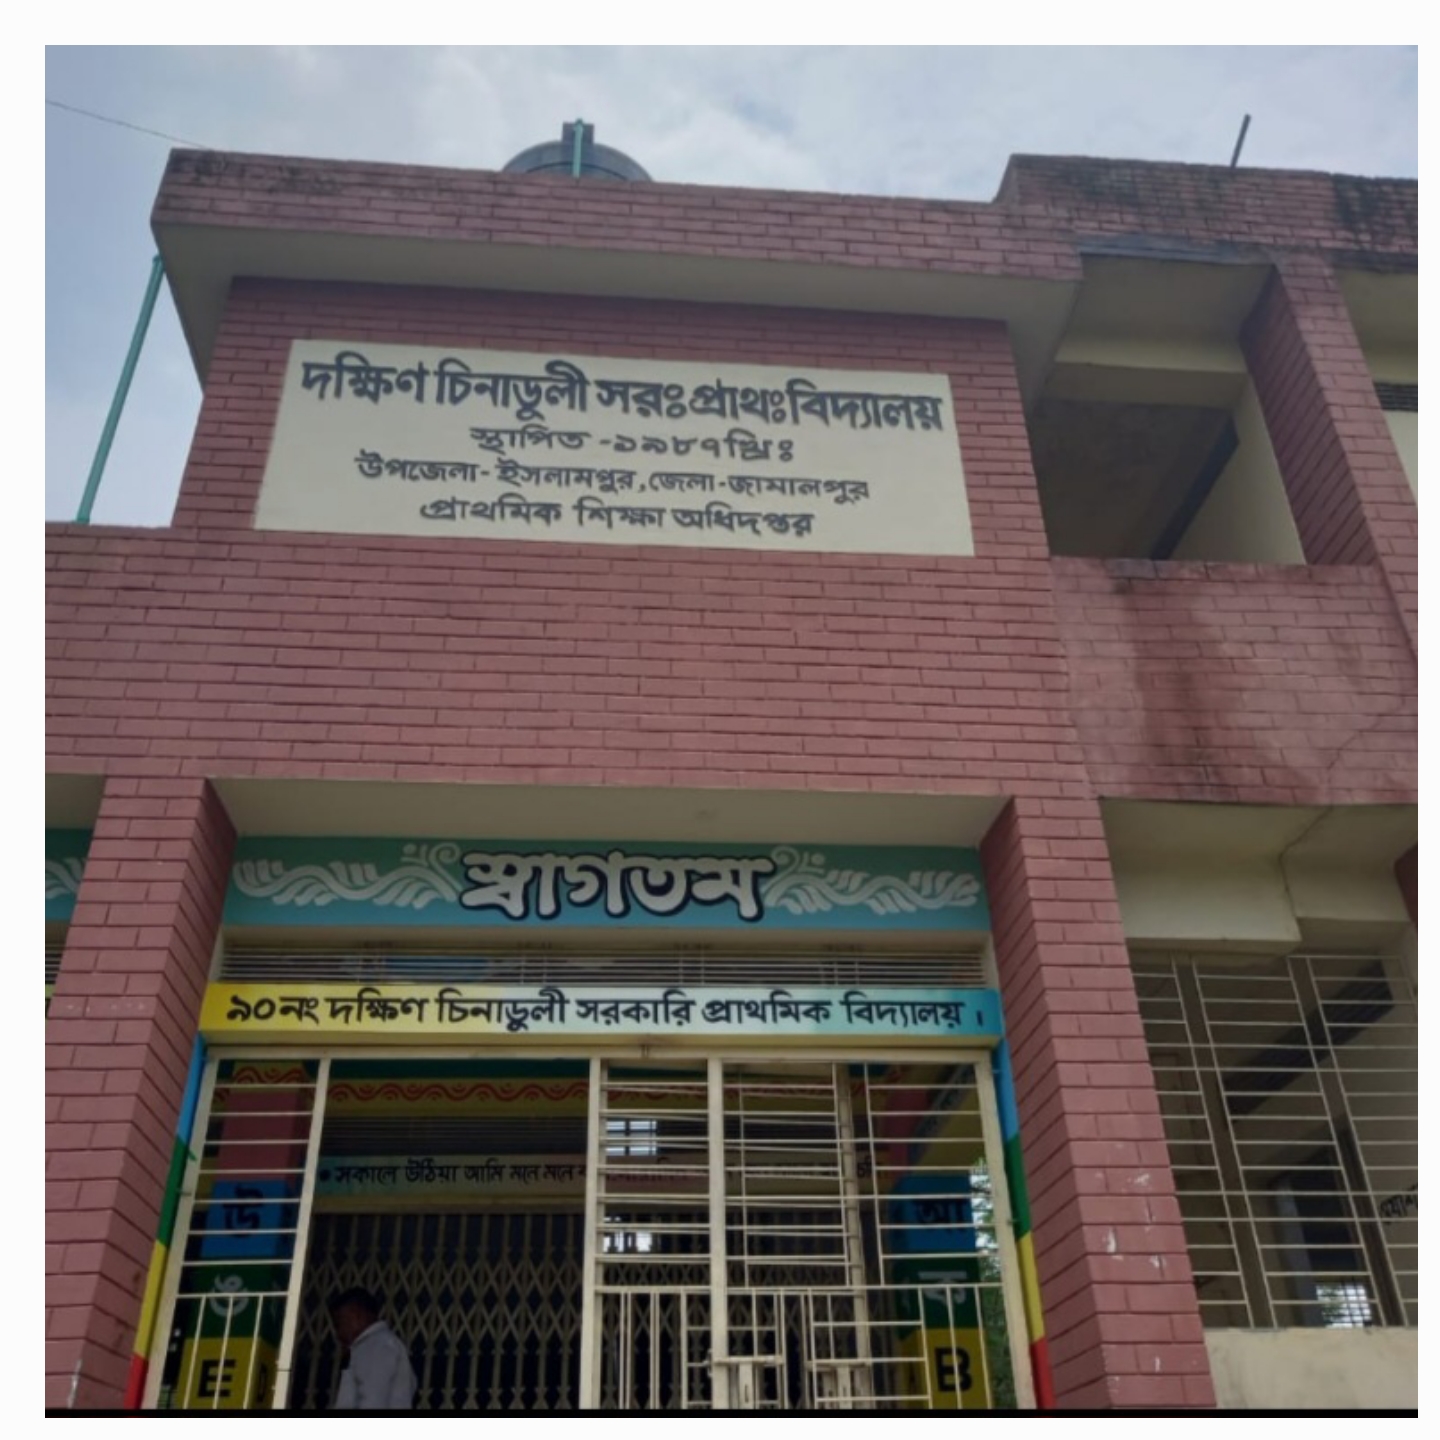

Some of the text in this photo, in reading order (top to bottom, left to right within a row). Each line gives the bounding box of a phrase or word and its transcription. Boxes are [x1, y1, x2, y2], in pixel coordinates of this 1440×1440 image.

[301, 350, 430, 404] দক্ষিণ
[433, 357, 589, 422] চিনাডুলী
[419, 492, 815, 537] প্রাথমিক শিক্ষা অধিদপ্তর
[324, 987, 429, 1024] দক্ষিণ
[436, 987, 568, 1032] চিনাডুলী
[575, 989, 696, 1027] সরকারি
[701, 989, 832, 1025] প্রাথমিক
[464, 1157, 506, 1184] আমি
[198, 1359, 236, 1397] E
[934, 1346, 972, 1393] B
